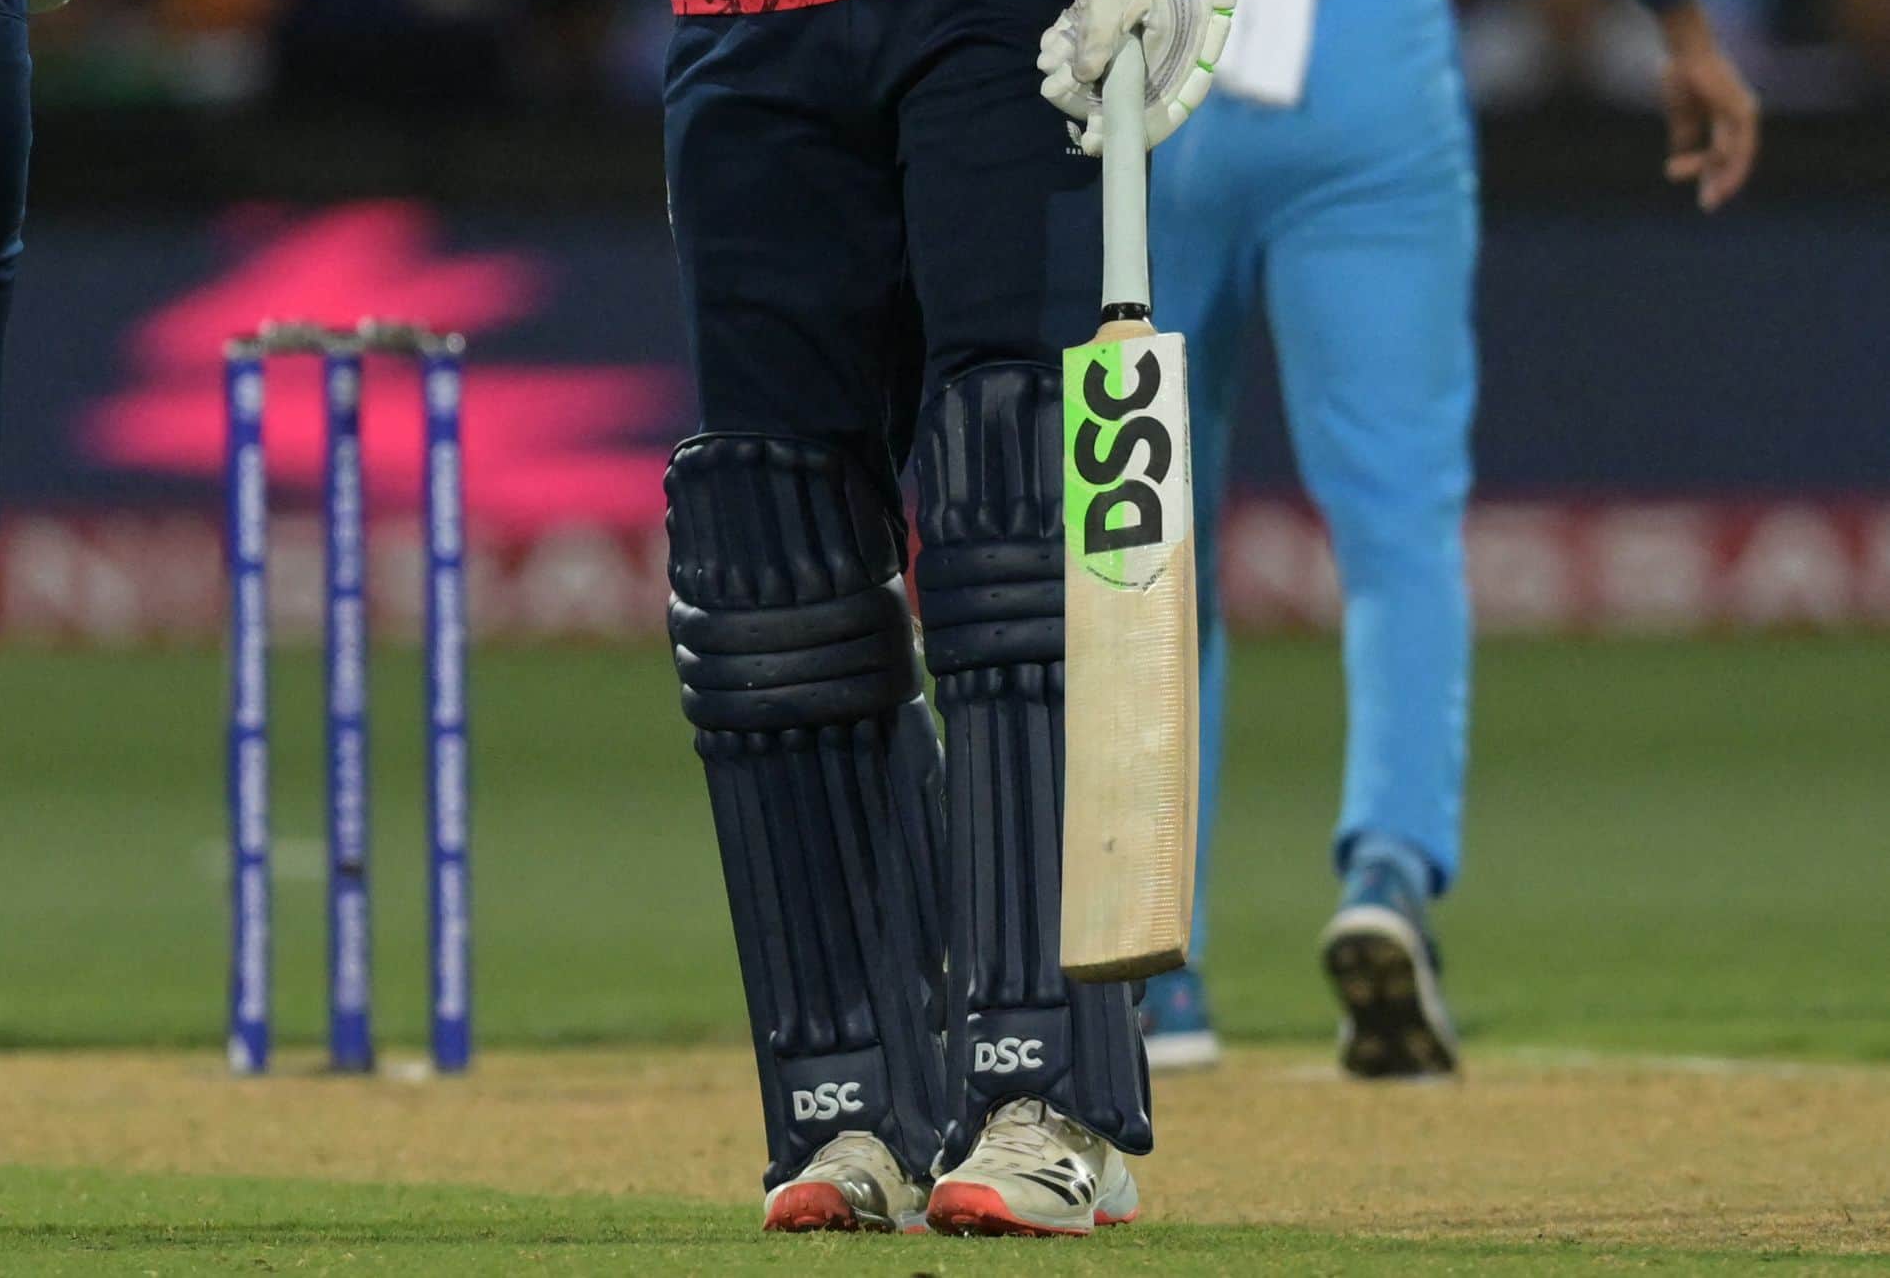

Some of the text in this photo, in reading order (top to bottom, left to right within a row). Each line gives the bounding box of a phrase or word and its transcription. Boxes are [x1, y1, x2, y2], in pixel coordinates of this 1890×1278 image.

[1074, 349, 1172, 555] DSC
[974, 1036, 1044, 1073] DSC
[792, 1081, 864, 1121] DSC
